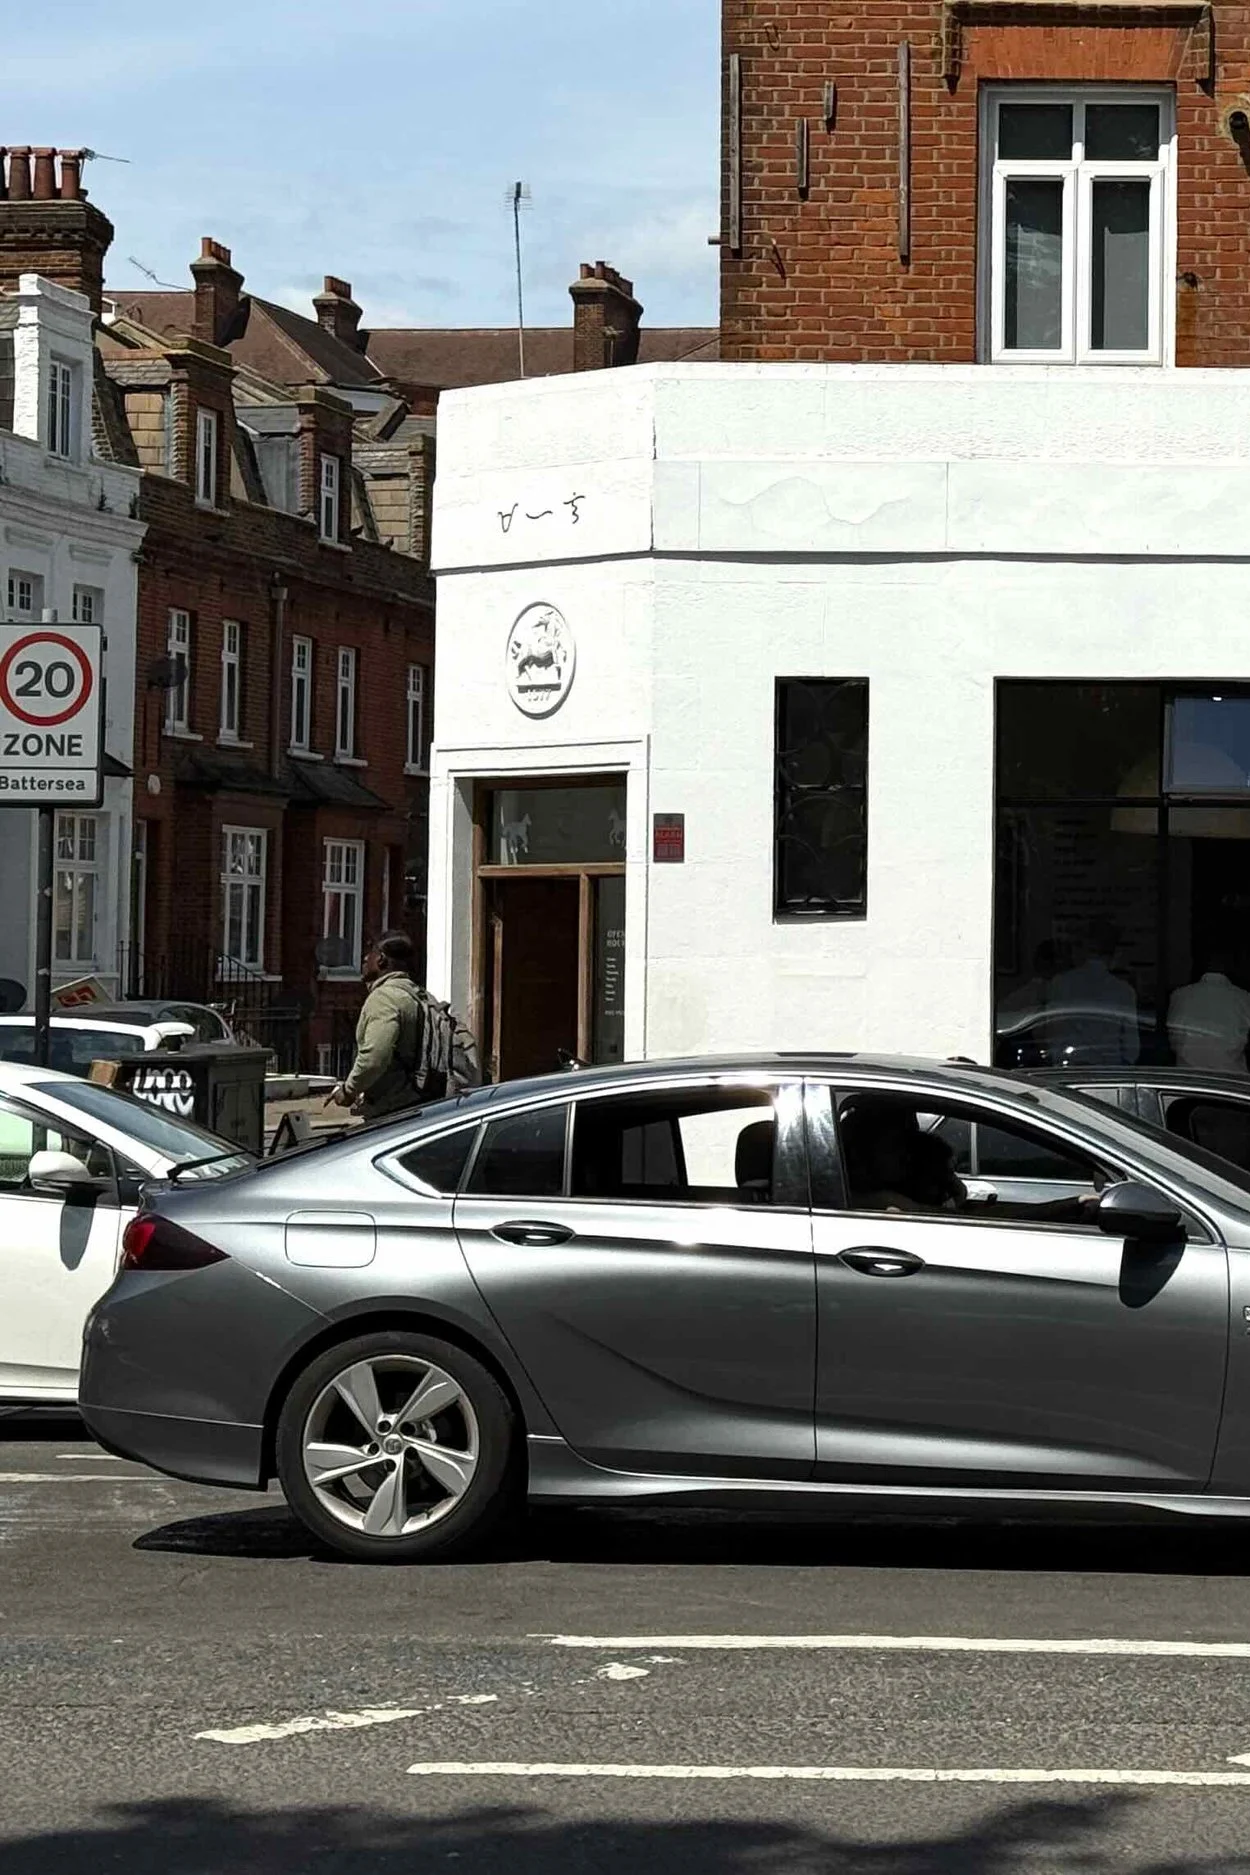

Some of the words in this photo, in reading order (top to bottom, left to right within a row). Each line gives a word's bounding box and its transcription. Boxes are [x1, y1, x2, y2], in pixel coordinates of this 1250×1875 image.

[15, 661, 75, 698] 20
[3, 733, 83, 757] ZONE
[0, 776, 86, 791] Battersea
